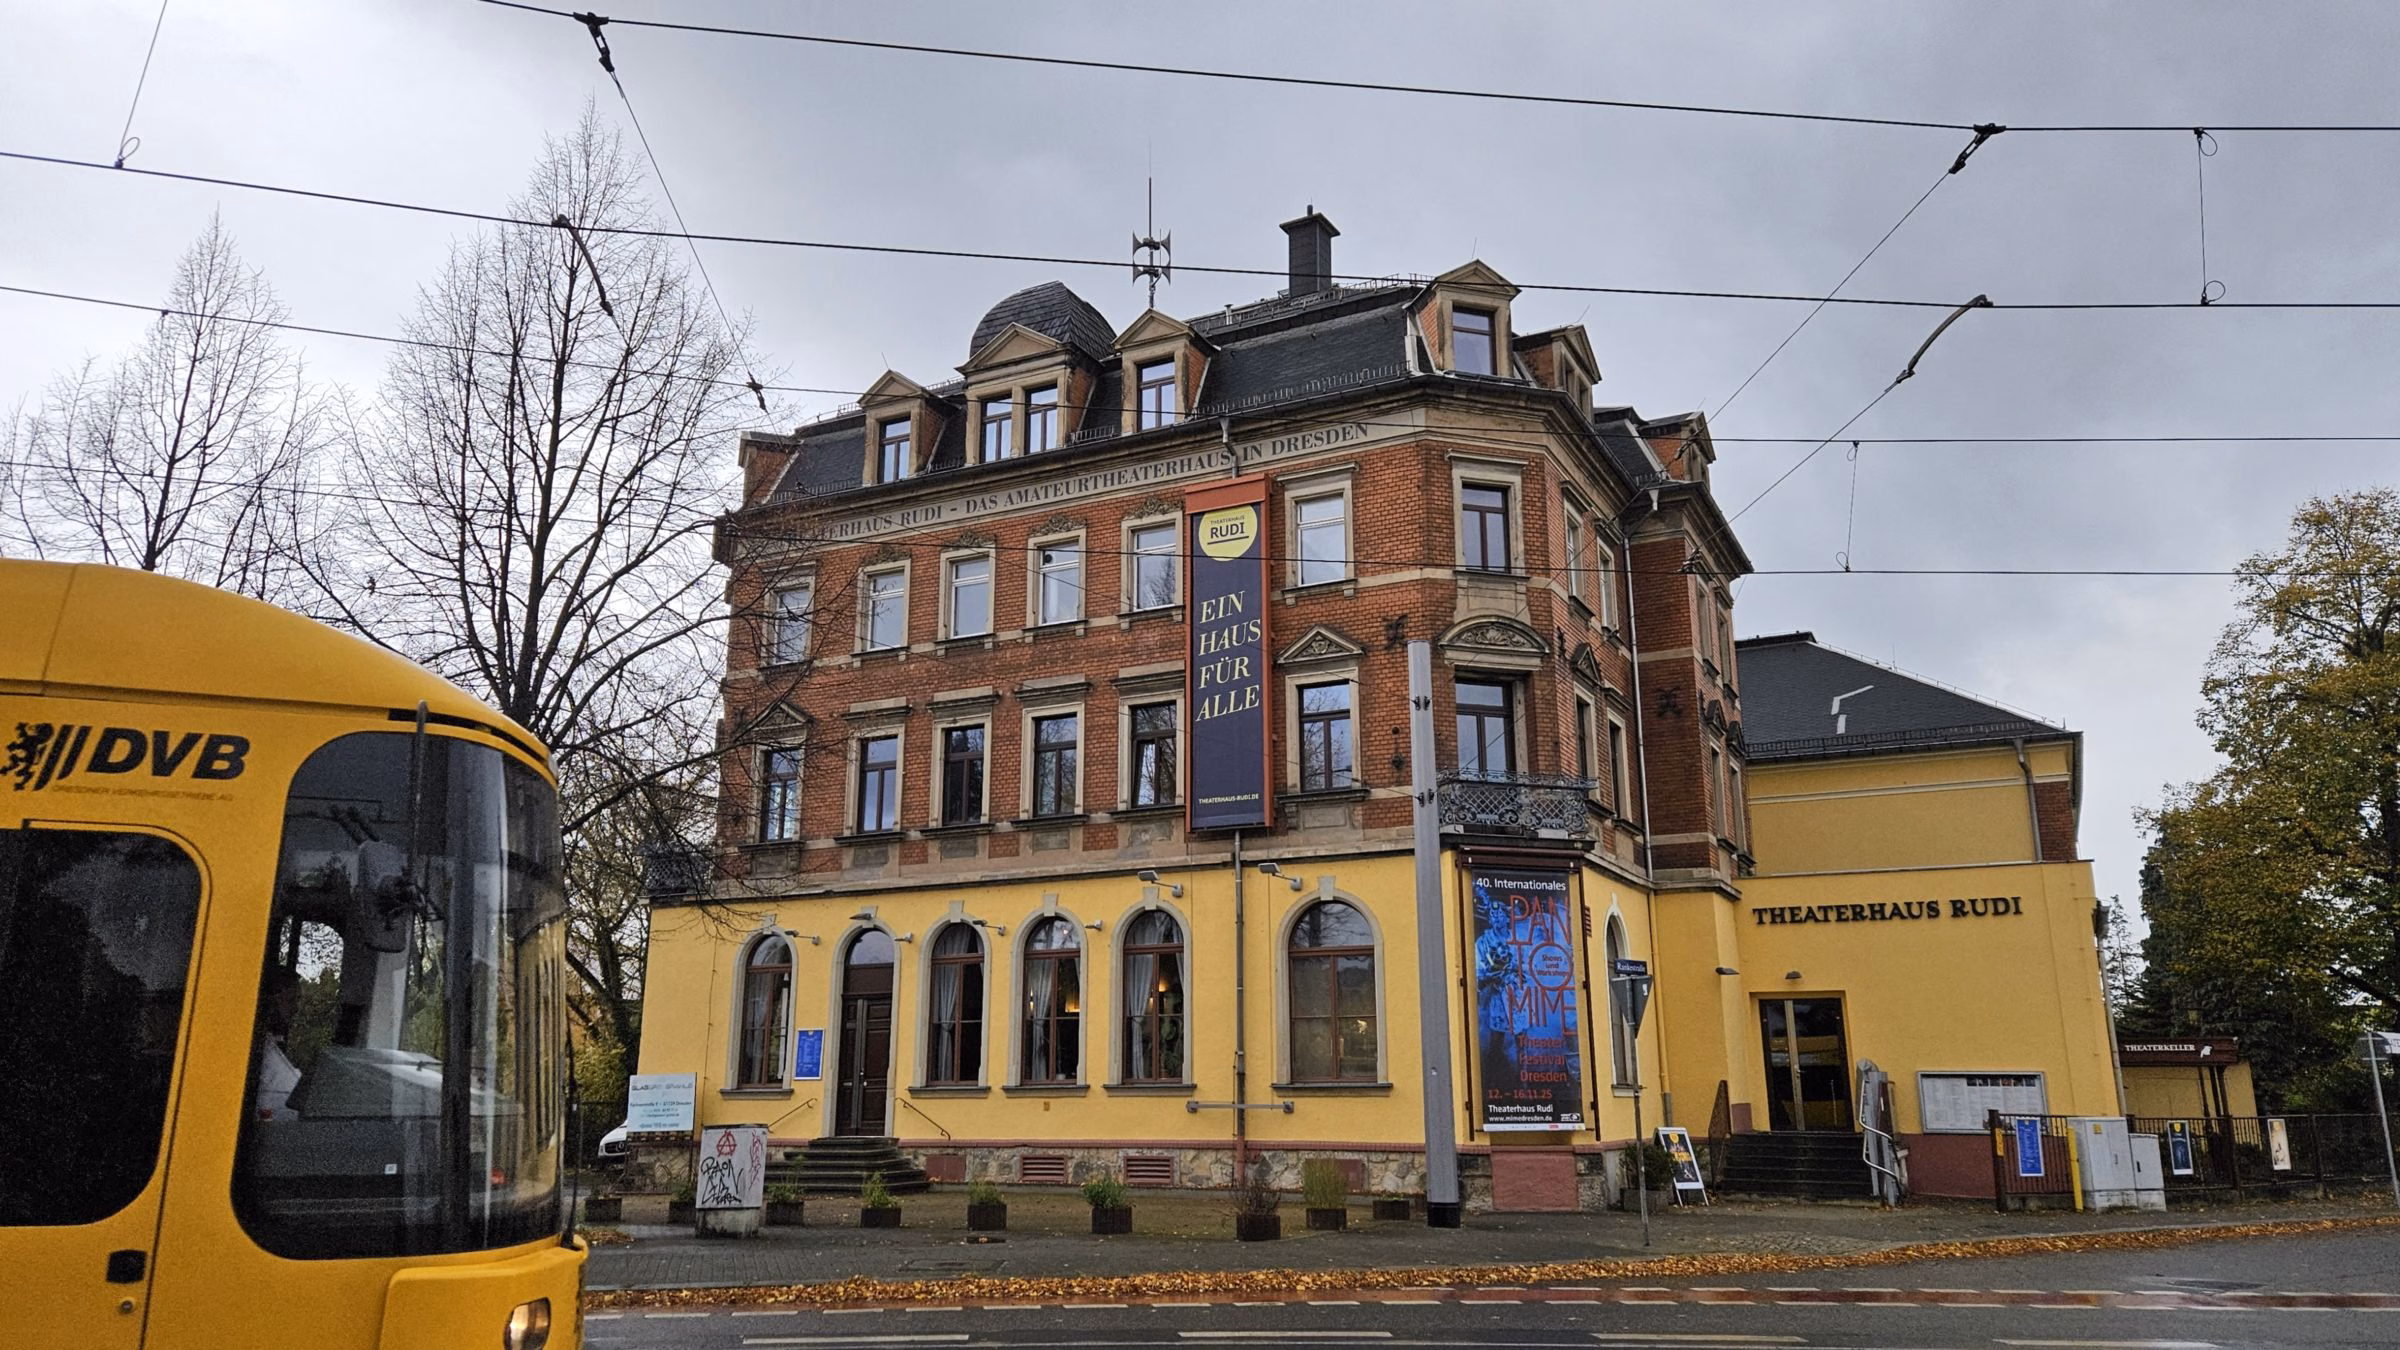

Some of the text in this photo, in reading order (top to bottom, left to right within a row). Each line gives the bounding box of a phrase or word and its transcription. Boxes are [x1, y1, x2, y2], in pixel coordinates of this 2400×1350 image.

[901, 505, 942, 525] RUDI
[966, 495, 998, 514] DAS
[1003, 452, 1231, 507] AMATEURTHEATERHAUS
[1243, 443, 1262, 462] IN
[1272, 424, 1369, 456] DRESDEN
[1210, 522, 1245, 539] RUDI
[1200, 590, 1245, 623] EIN
[1198, 619, 1261, 656] HAUS
[1198, 656, 1251, 689] FÜR
[1195, 685, 1260, 721] ALLE
[86, 727, 250, 780] DVB
[1198, 793, 1259, 805] THEATERHAUS-RUDI.DE
[1476, 877, 1566, 891] 40. Internationales
[1506, 895, 1571, 944] PAN
[1753, 896, 2023, 925] THEATERHAUS RUDI
[1508, 985, 1578, 1037] MIME
[1519, 1036, 1565, 1048] Theater
[2125, 1044, 2196, 1052] THEATERKELLER
[1519, 1054, 1565, 1065] Festival
[1520, 1071, 1567, 1082] Dresden
[1488, 1089, 1502, 1099] 12.
[1488, 1104, 1554, 1113] Theaterhaus Rudi
